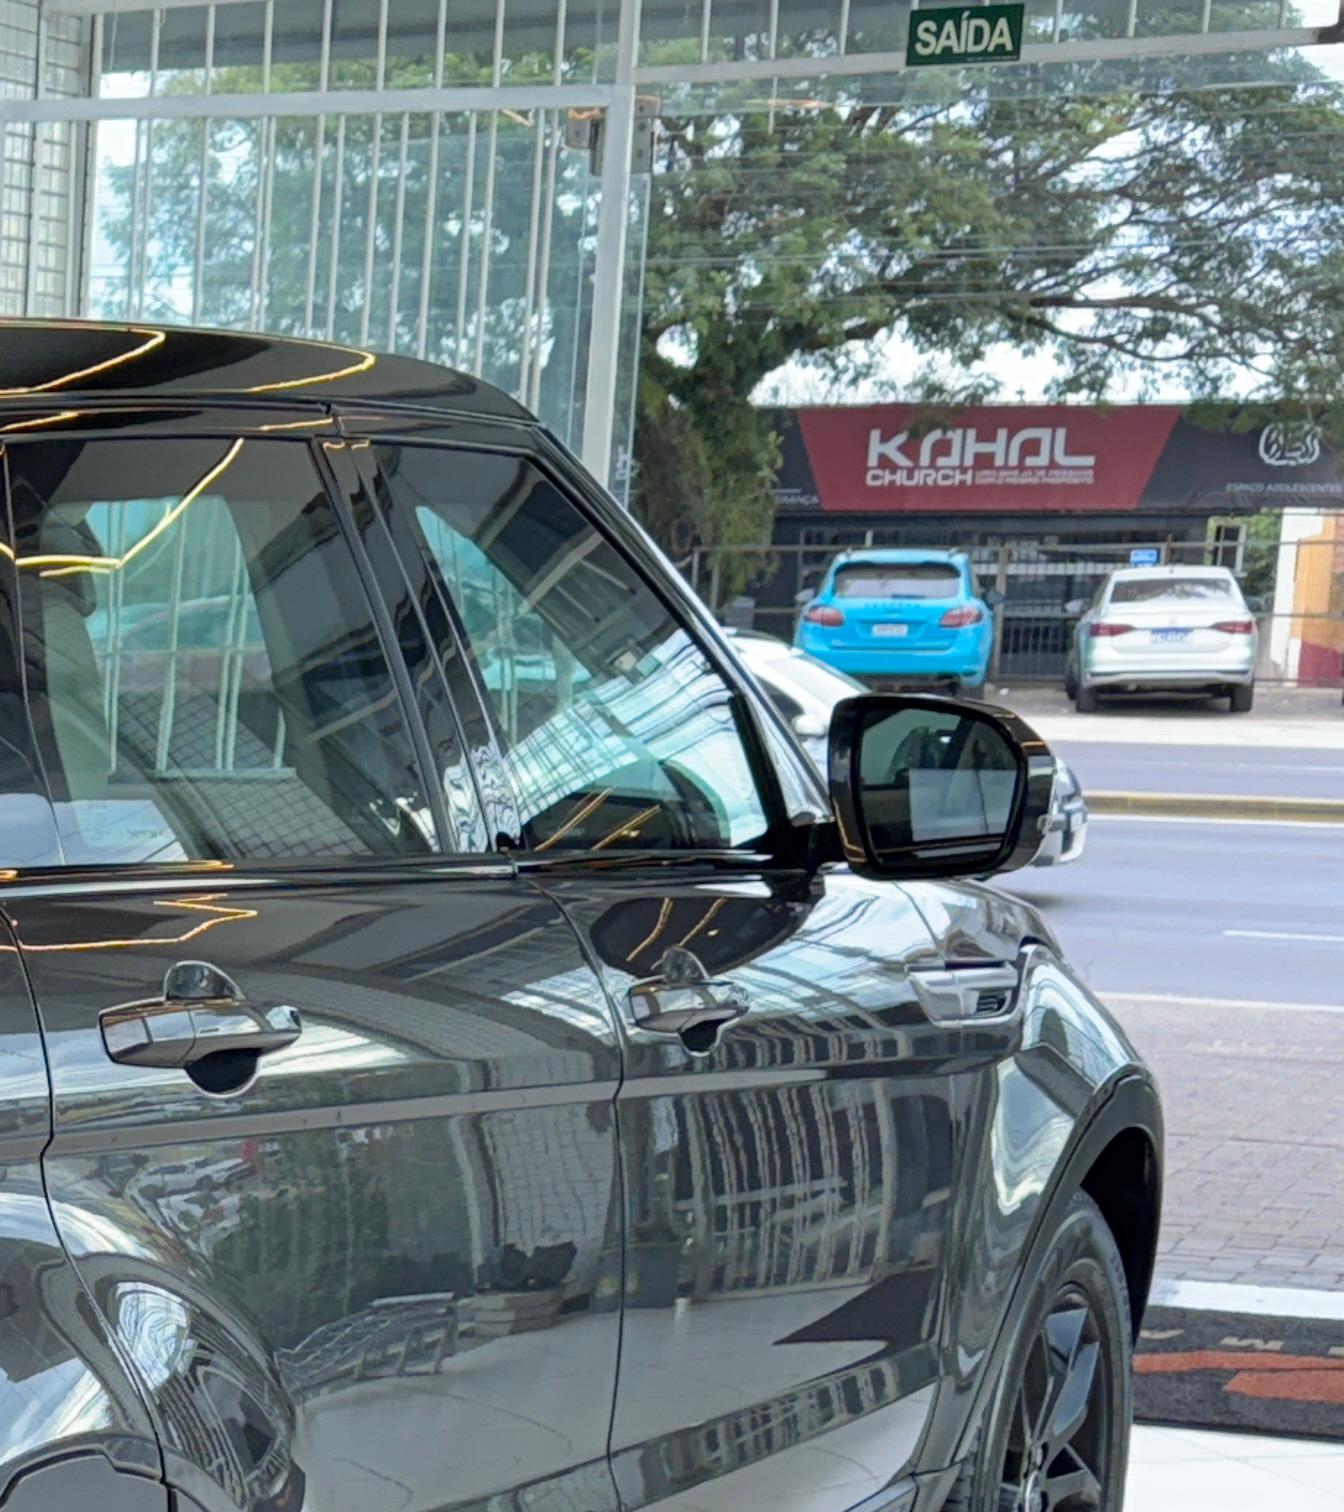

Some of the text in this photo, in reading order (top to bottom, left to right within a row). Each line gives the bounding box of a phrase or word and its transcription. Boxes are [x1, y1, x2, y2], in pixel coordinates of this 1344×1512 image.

[914, 10, 1013, 56] SAÍDA
[867, 426, 1096, 467] KAHAL
[865, 469, 972, 487] CHURCH
